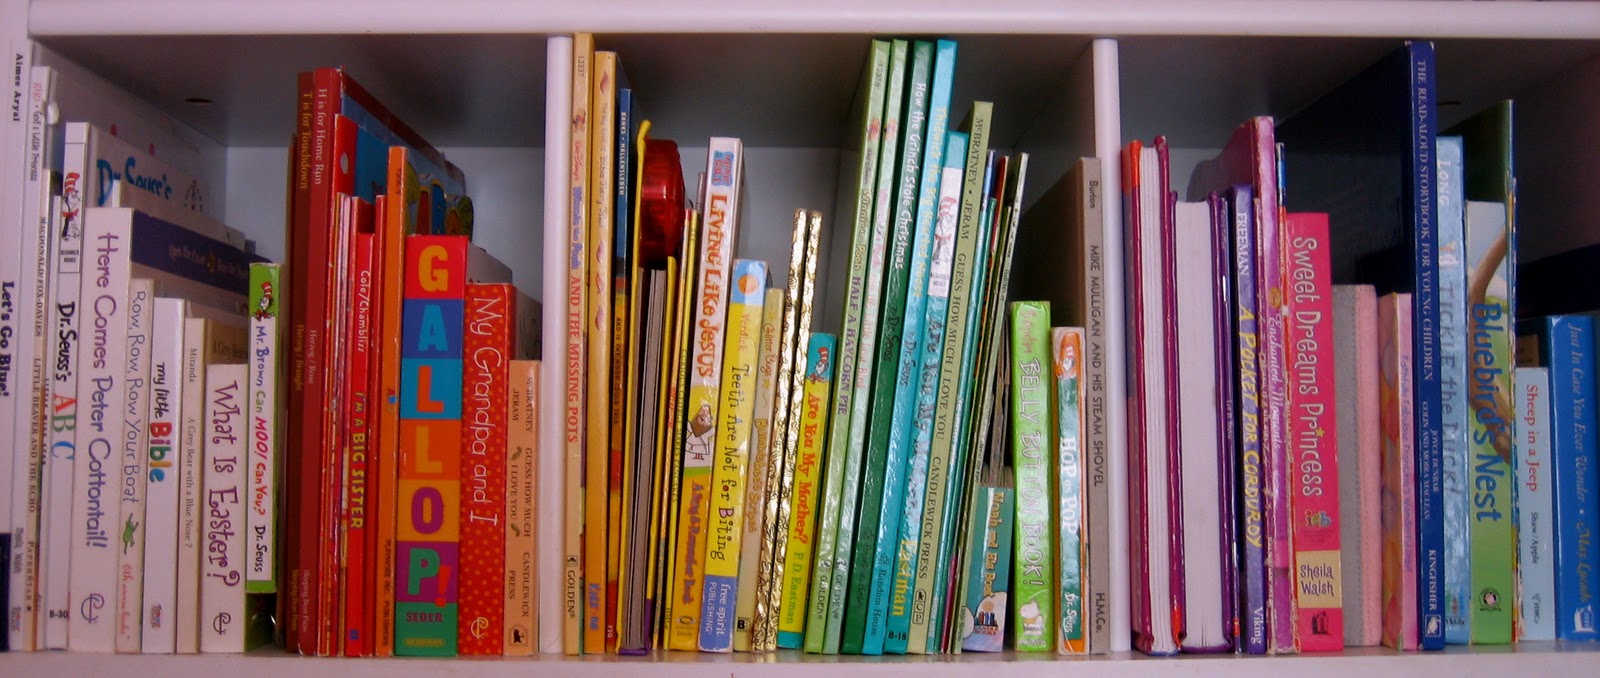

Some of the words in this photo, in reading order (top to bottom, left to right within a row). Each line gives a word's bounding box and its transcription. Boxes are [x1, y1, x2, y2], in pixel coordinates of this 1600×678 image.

[14, 53, 23, 86] Aimee
[1417, 60, 1427, 84] THE
[12, 92, 21, 122] Aryal
[914, 83, 926, 107] How
[301, 112, 311, 127] for
[316, 111, 326, 126] for
[911, 111, 923, 130] the
[1418, 88, 1429, 162] READ-ALOUD
[300, 130, 311, 189] Touchdown
[315, 130, 326, 161] Home
[906, 134, 921, 172] Grinch
[314, 164, 325, 185] Run
[903, 176, 916, 205] Stole
[1089, 180, 1098, 208] Burton
[1420, 166, 1430, 239] STORYBOOK
[960, 200, 973, 239] JERAM
[895, 210, 911, 269] Christmas
[1237, 212, 1249, 276] FREEMAN
[1421, 243, 1430, 267] FOR
[97, 233, 119, 288] Here
[954, 253, 967, 292] GUESS
[1090, 245, 1099, 271] MIKE
[1294, 237, 1318, 303] Sweet
[1, 281, 14, 321] Let's
[570, 276, 580, 306] AND
[849, 276, 861, 311] HALF
[1091, 276, 1100, 336] MULLIGAN
[1422, 271, 1431, 314] YOUNG
[57, 302, 75, 328] Dr.
[129, 291, 146, 330] Row,
[358, 270, 370, 352] Cole/Chambliss
[469, 298, 502, 335] My
[570, 310, 580, 338] THE
[949, 296, 961, 326] HOW
[1239, 304, 1254, 321] A
[0, 326, 12, 349] Go
[93, 295, 116, 368] Comes
[256, 325, 266, 344] Mr.
[307, 330, 317, 357] Herzog
[945, 329, 956, 365] MUCH
[1568, 322, 1582, 348] Just
[55, 330, 78, 382] Seuss's
[127, 334, 145, 374] Row,
[189, 348, 197, 383] Miranda
[761, 354, 777, 377] Bugs
[841, 328, 856, 391] HAYCORN
[1092, 343, 1102, 369] AND
[1268, 314, 1281, 384] Enchanted
[1295, 311, 1321, 394] Dreams
[1422, 318, 1433, 381] CHILDREN
[1572, 352, 1582, 364] In
[0, 353, 11, 397] Blue!
[153, 362, 167, 385] my
[256, 347, 269, 387] Brown
[308, 366, 316, 384] Rose
[568, 343, 580, 403] MISSING
[1093, 373, 1102, 391] HIS
[1239, 332, 1258, 407] POCKET
[1472, 303, 1506, 445] Bluebird's
[1572, 368, 1584, 394] Case
[128, 379, 141, 415] Row
[255, 391, 265, 413] Can
[470, 347, 501, 456] Grandpa
[728, 364, 749, 408] Teeth
[939, 378, 951, 410] LOVE
[1019, 358, 1041, 424] BELLY
[1440, 377, 1457, 414] the
[31, 396, 39, 435] BEAVER
[91, 375, 113, 432] Peter
[154, 389, 171, 419] little
[212, 381, 240, 445] What
[808, 392, 819, 419] Are
[837, 394, 849, 415] PIE
[1093, 397, 1102, 435] STEAM
[1523, 385, 1539, 426] Sheep
[1573, 398, 1584, 420] You
[125, 418, 140, 459] Your
[184, 426, 195, 446] Grey
[255, 416, 268, 459] MOO!
[355, 418, 365, 427] A
[568, 406, 579, 442] POTS
[726, 414, 745, 441] Are
[804, 424, 818, 448] You
[935, 414, 947, 440] YOU
[1244, 412, 1258, 443] FOR
[1527, 431, 1539, 444] in
[149, 422, 173, 483] Bible
[187, 449, 195, 467] Bear
[352, 433, 365, 462] BIG
[722, 446, 739, 470] Not
[1060, 435, 1076, 477] HOP
[1299, 403, 1323, 496] Princess
[1430, 429, 1438, 455] JOYCE
[213, 456, 237, 473] Is
[256, 463, 266, 485] Can
[524, 448, 532, 477] GUESS
[798, 452, 813, 475] My
[1020, 432, 1041, 514] BUTTON
[1093, 441, 1103, 487] SHOVEL
[1431, 459, 1439, 493] DUNBAR
[1526, 461, 1540, 492] Jeep
[86, 438, 111, 548] Cottontail!
[123, 465, 139, 504] Boat
[187, 470, 195, 489] with
[473, 464, 491, 502] and
[510, 470, 518, 497] LOVE
[524, 481, 532, 500] HOW
[720, 479, 735, 501] for
[1474, 454, 1504, 522] Nest
[185, 498, 194, 516] Blue
[255, 485, 267, 515] You?
[351, 469, 364, 529] SISTER
[793, 481, 812, 544] Mother?
[924, 456, 941, 540] CANDLEWICK
[989, 491, 1004, 527] Noah
[1244, 450, 1261, 548] CORDUROY
[185, 519, 193, 541] Nose
[470, 510, 497, 526] I
[1061, 496, 1076, 534] POP
[207, 487, 240, 586] Easter?
[255, 525, 266, 541] Dr.
[711, 507, 734, 560] Biting
[254, 544, 267, 572] Seuss
[918, 543, 930, 579] PRESS
[1022, 521, 1044, 585] BOOK!
[522, 552, 530, 617] CANDLEWICK
[875, 570, 887, 606] Random
[1300, 564, 1334, 579] Sheila
[1428, 550, 1437, 610] KINGFISHER
[719, 583, 730, 604] free
[785, 576, 800, 624] Eastman
[1065, 593, 1077, 607] Dr.
[1301, 581, 1334, 596] Walsh
[406, 611, 442, 622] SEDER
[716, 607, 728, 635] spirit
[871, 609, 884, 637] House
[1064, 609, 1076, 633] Seuss
[1251, 607, 1263, 644] Viking
